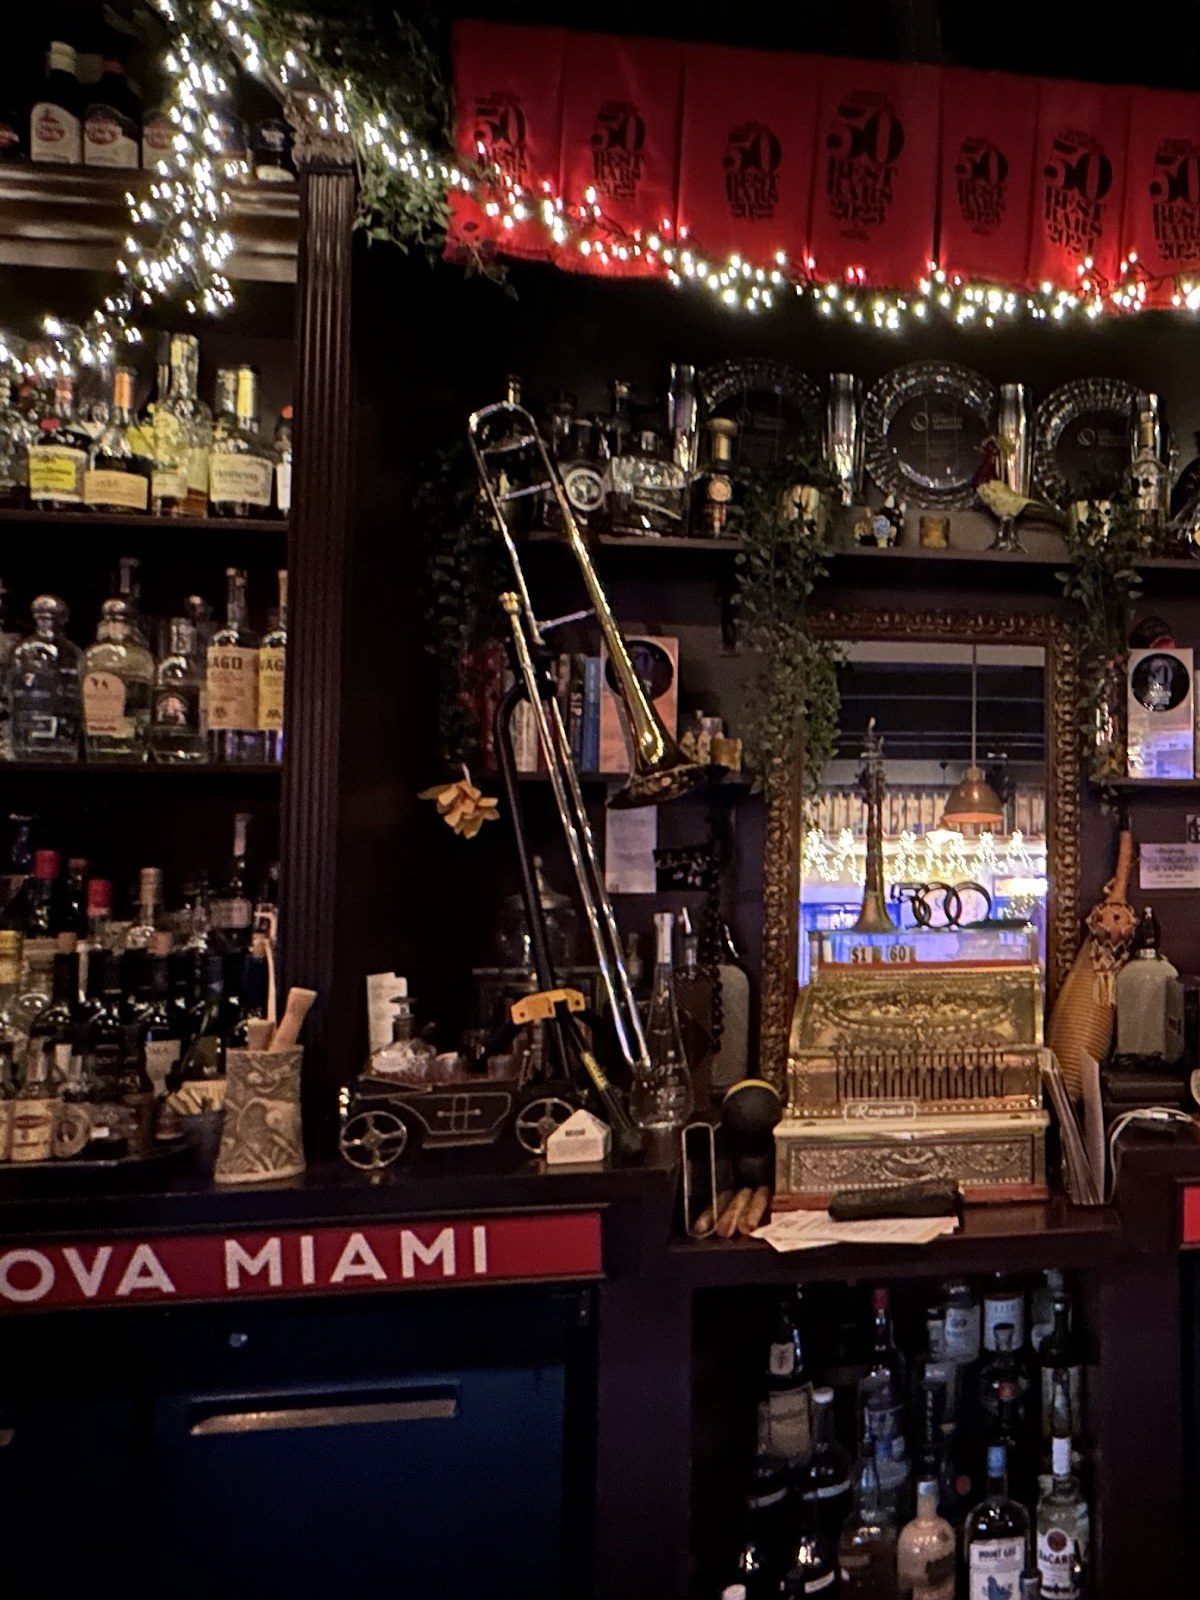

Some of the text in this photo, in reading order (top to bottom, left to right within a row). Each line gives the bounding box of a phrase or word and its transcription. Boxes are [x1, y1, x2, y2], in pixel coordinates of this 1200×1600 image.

[474, 105, 527, 146] 50
[591, 112, 646, 153] 50
[825, 103, 905, 164] 50
[723, 131, 783, 173] 50
[828, 155, 900, 186] BEST
[954, 142, 1009, 186] 50
[1043, 138, 1112, 201] 50
[1045, 185, 1107, 221] BEST
[1045, 203, 1103, 239] BARS
[209, 656, 243, 670] AGO
[0, 1224, 488, 1303] OVA MIAMI
